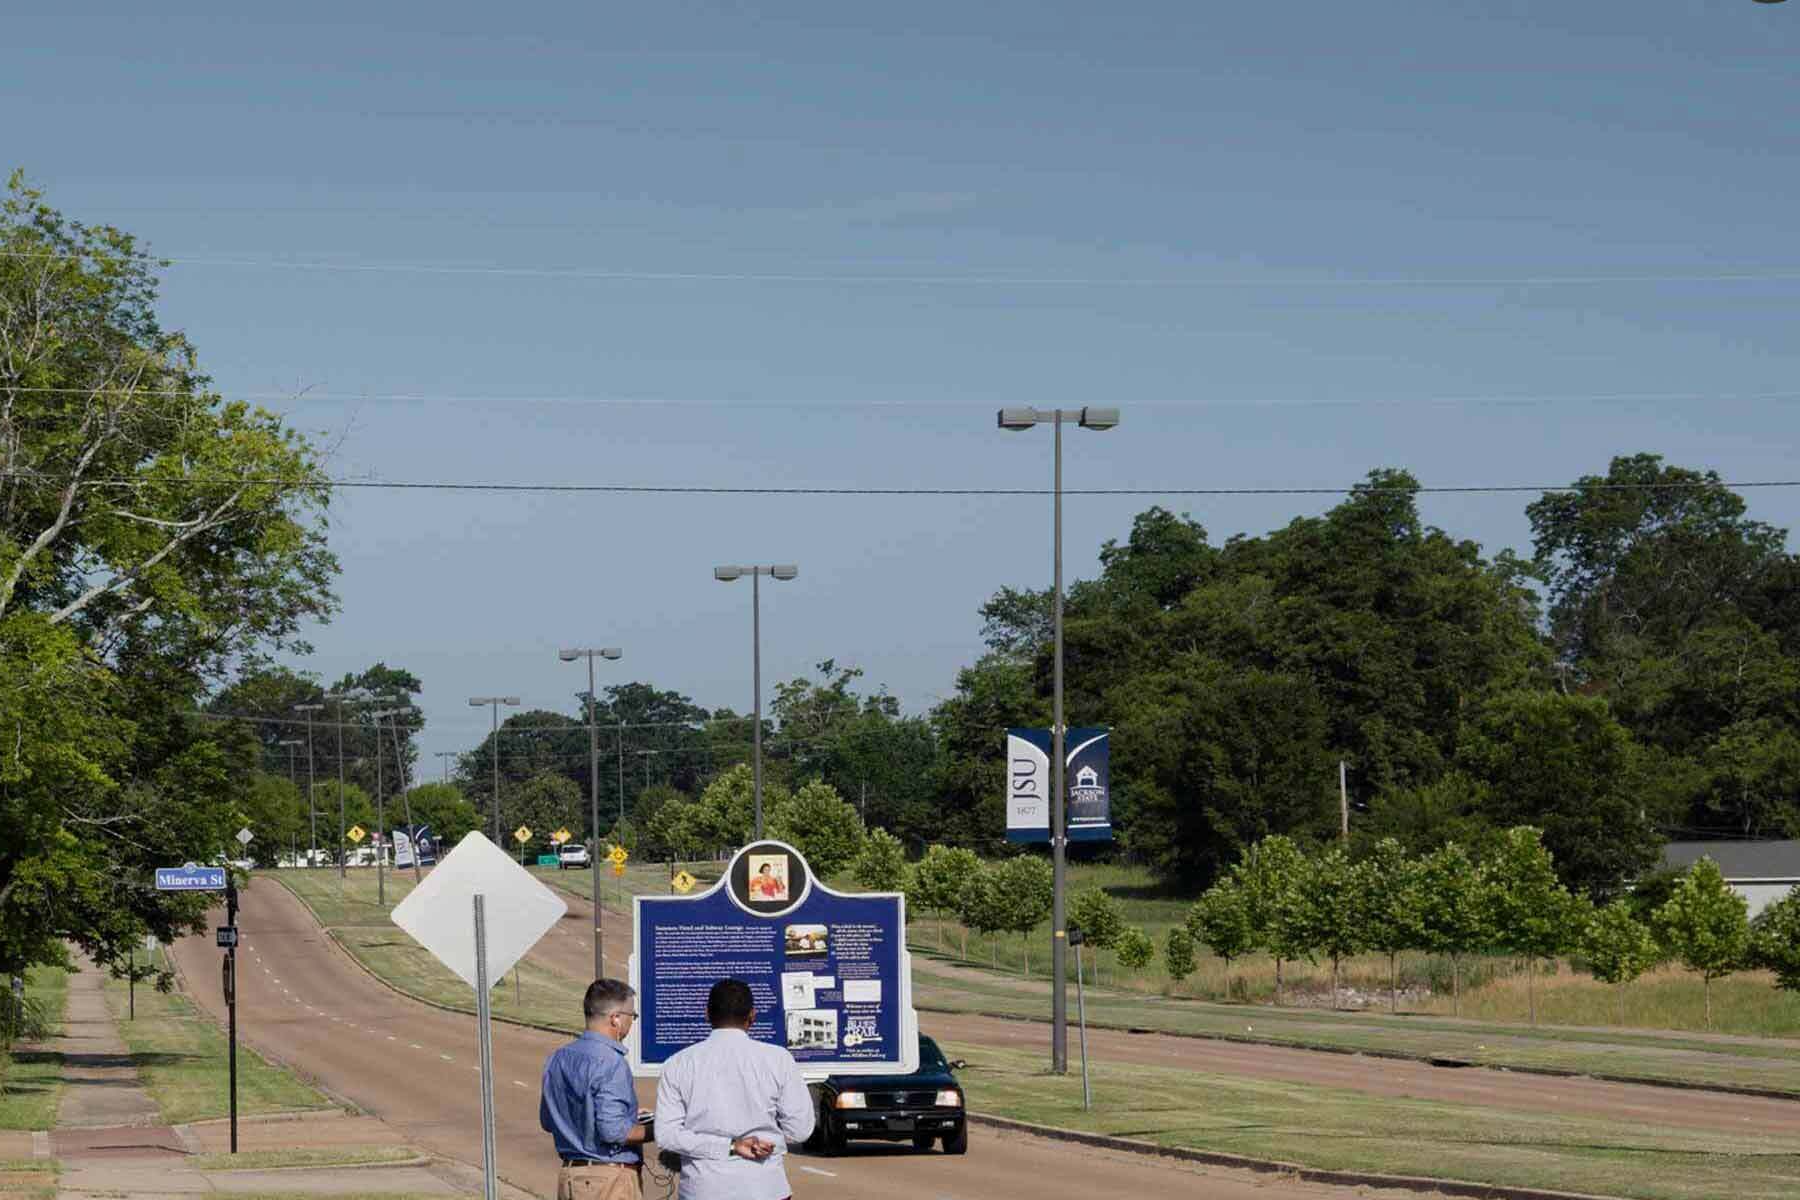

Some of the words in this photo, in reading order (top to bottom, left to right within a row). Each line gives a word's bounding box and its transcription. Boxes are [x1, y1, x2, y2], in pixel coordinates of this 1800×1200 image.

[1013, 758, 1042, 801] JSU
[159, 874, 207, 886] Minerva
[210, 874, 222, 886] St
